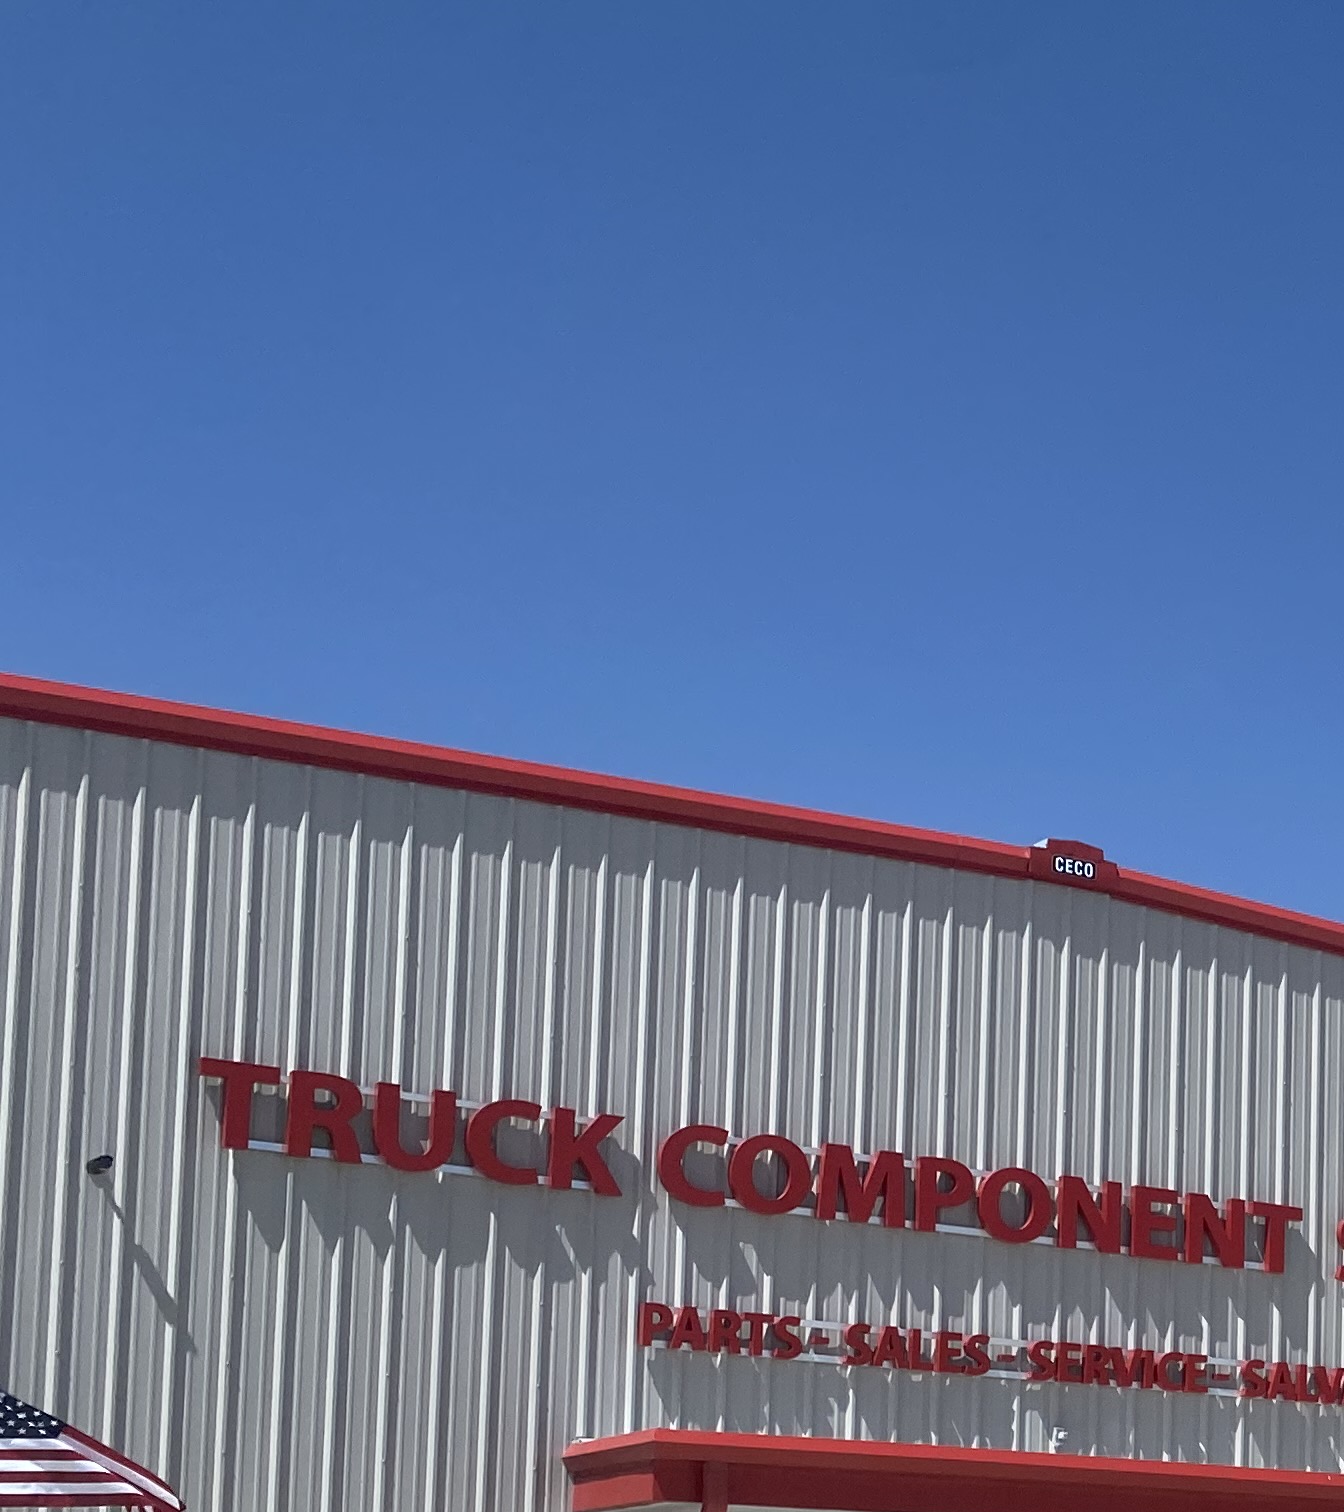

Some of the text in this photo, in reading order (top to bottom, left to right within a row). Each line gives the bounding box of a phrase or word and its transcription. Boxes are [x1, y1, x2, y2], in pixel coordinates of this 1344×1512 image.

[1055, 857, 1094, 878] CECO
[199, 1057, 624, 1197] TRUCK
[656, 1124, 1303, 1274] COMPONENT
[639, 1302, 802, 1360] PARTS
[842, 1323, 991, 1376] SALES
[1027, 1340, 1209, 1393] SERVICE
